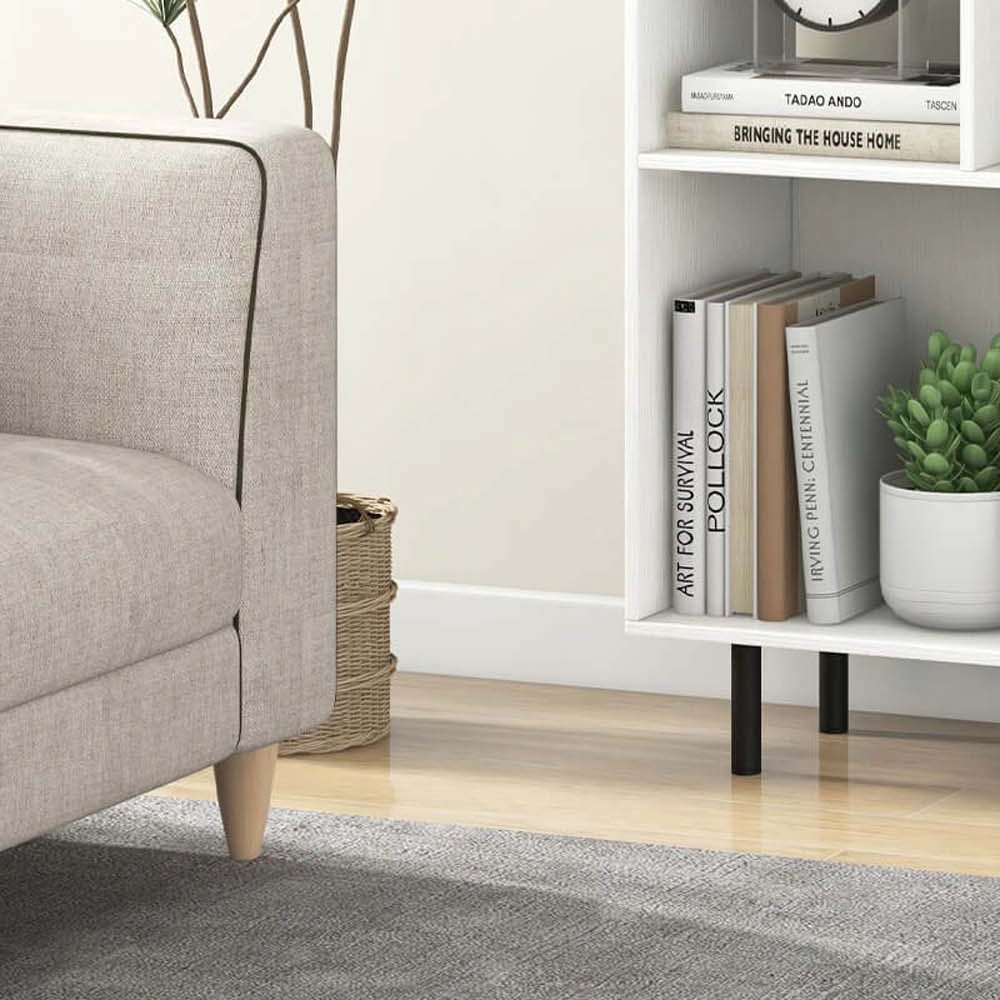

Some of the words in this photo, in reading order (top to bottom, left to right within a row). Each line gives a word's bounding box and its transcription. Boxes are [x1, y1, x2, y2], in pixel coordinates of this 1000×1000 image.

[784, 93, 825, 107] TADAO
[828, 95, 862, 109] ANDO
[734, 125, 792, 145] BRINGING
[796, 129, 819, 146] THE
[823, 130, 863, 149] HOUSE
[866, 132, 901, 150] HOME
[798, 379, 815, 473] CENTENNIAL
[676, 430, 695, 513] SURVIVAL
[707, 388, 726, 534] POLLOCK
[804, 478, 819, 521] PENN:
[676, 519, 694, 556] FOR
[809, 526, 824, 582] IRVING
[675, 561, 695, 598] ART
